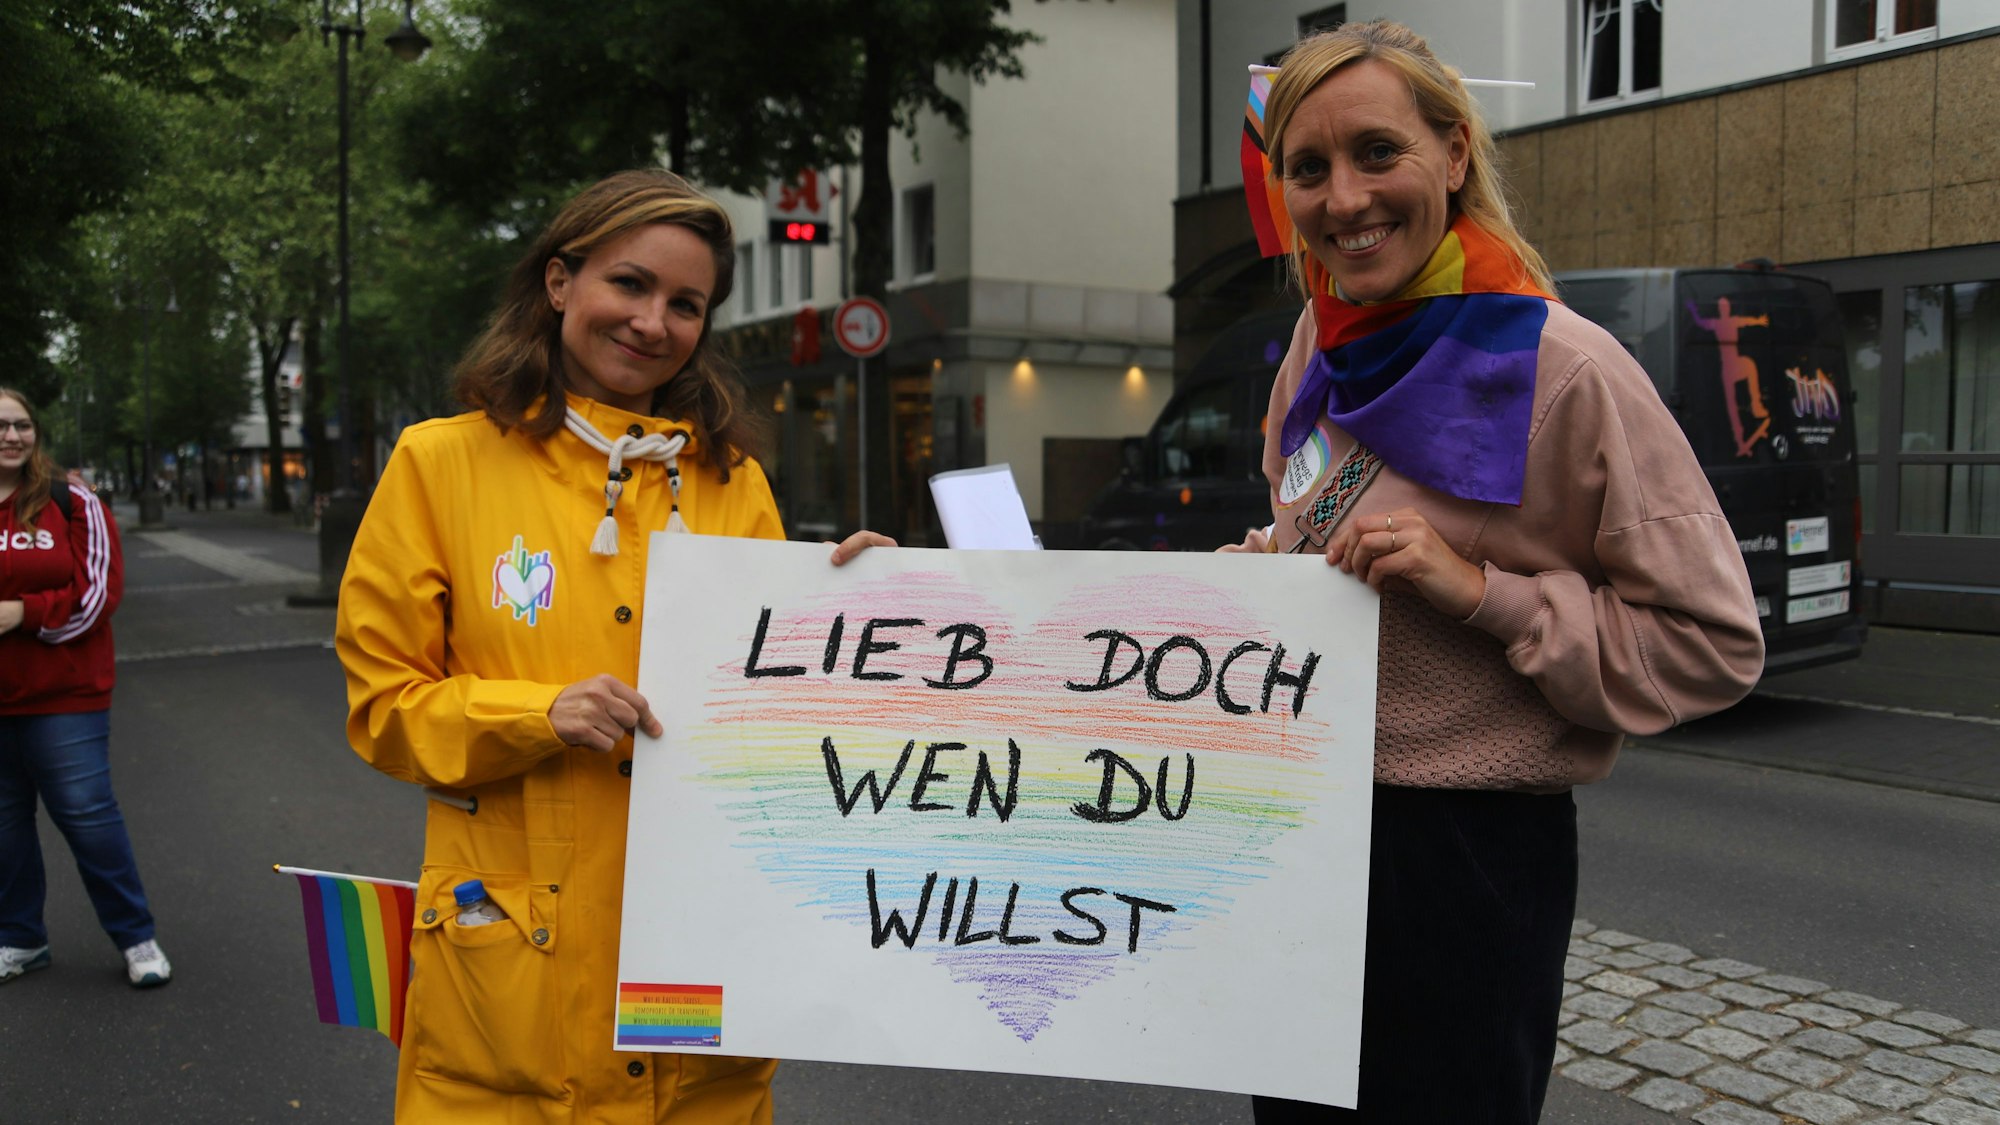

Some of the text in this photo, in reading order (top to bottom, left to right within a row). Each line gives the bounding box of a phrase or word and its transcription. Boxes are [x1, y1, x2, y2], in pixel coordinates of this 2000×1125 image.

[744, 606, 1321, 719] LIEB DOCH
[821, 737, 1194, 823] WEN DU
[867, 869, 1177, 953] WILLST
